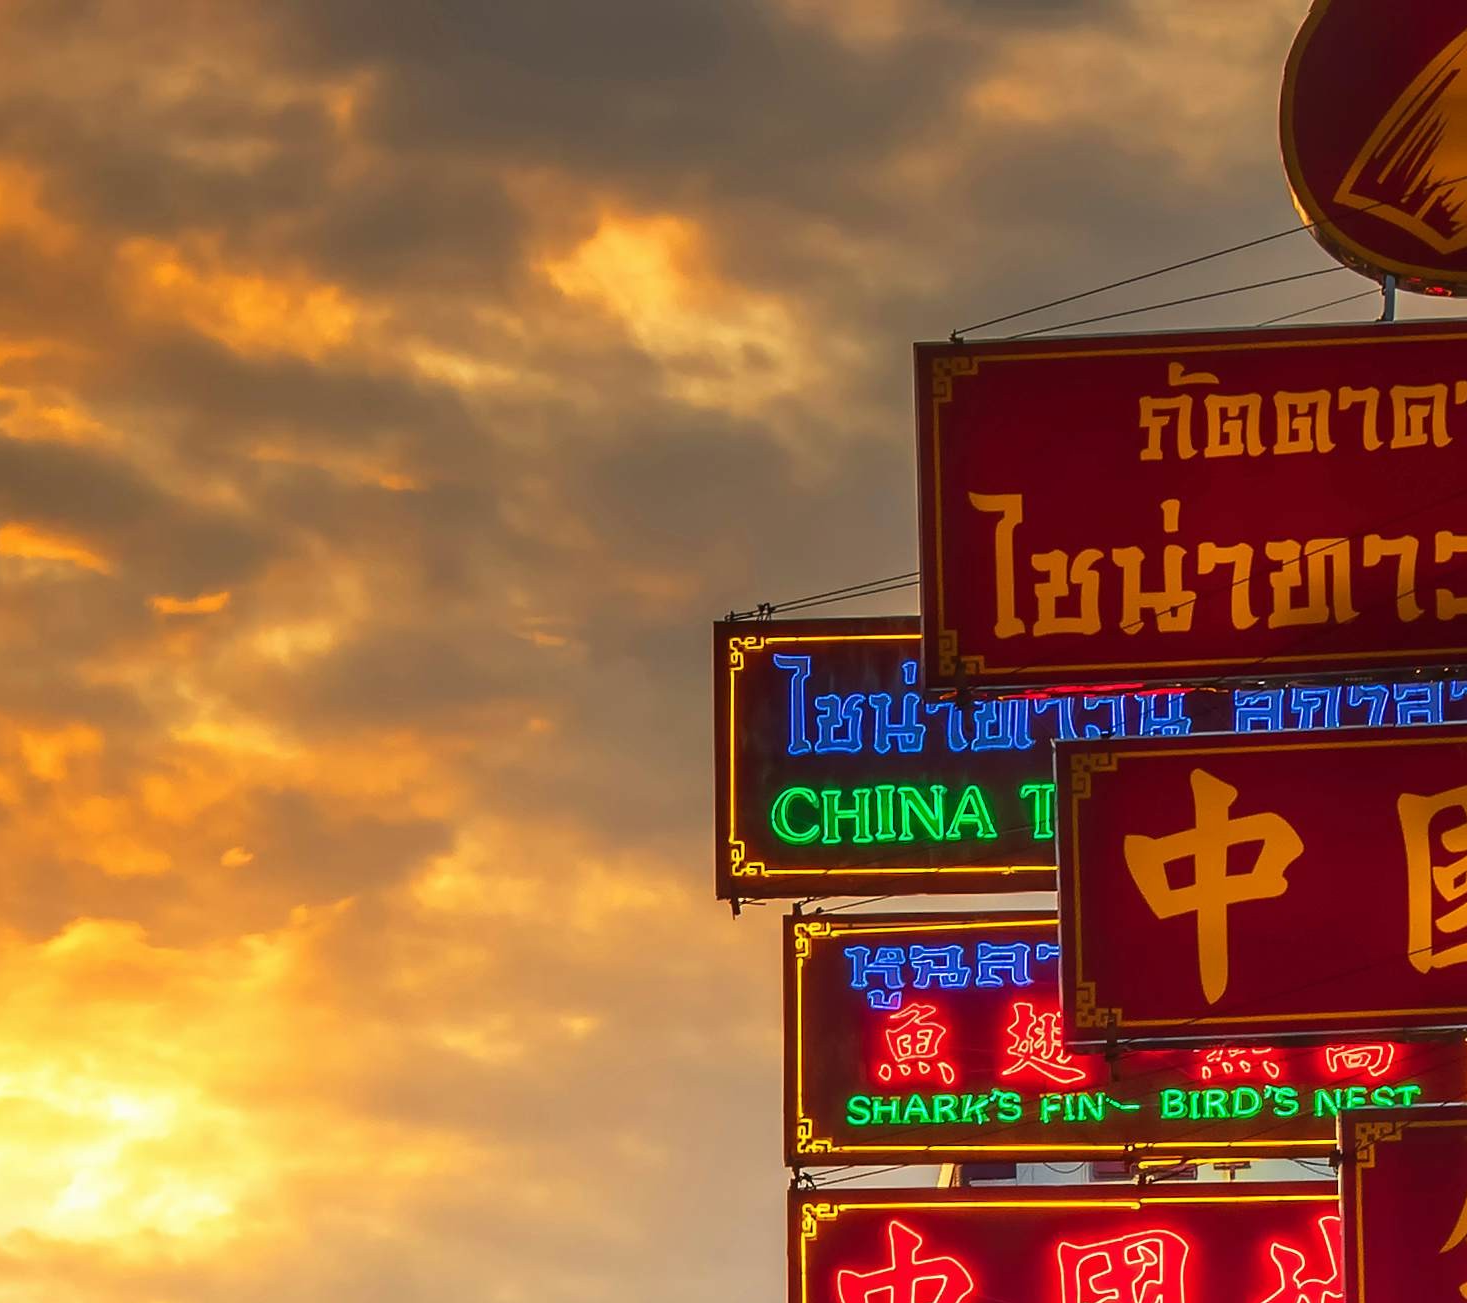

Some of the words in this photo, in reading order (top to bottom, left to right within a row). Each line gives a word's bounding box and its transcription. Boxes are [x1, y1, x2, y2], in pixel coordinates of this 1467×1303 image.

[770, 785, 997, 847] CHINA
[846, 1089, 1024, 1126] SHARK'S
[1159, 1084, 1300, 1120] BIRD'S
